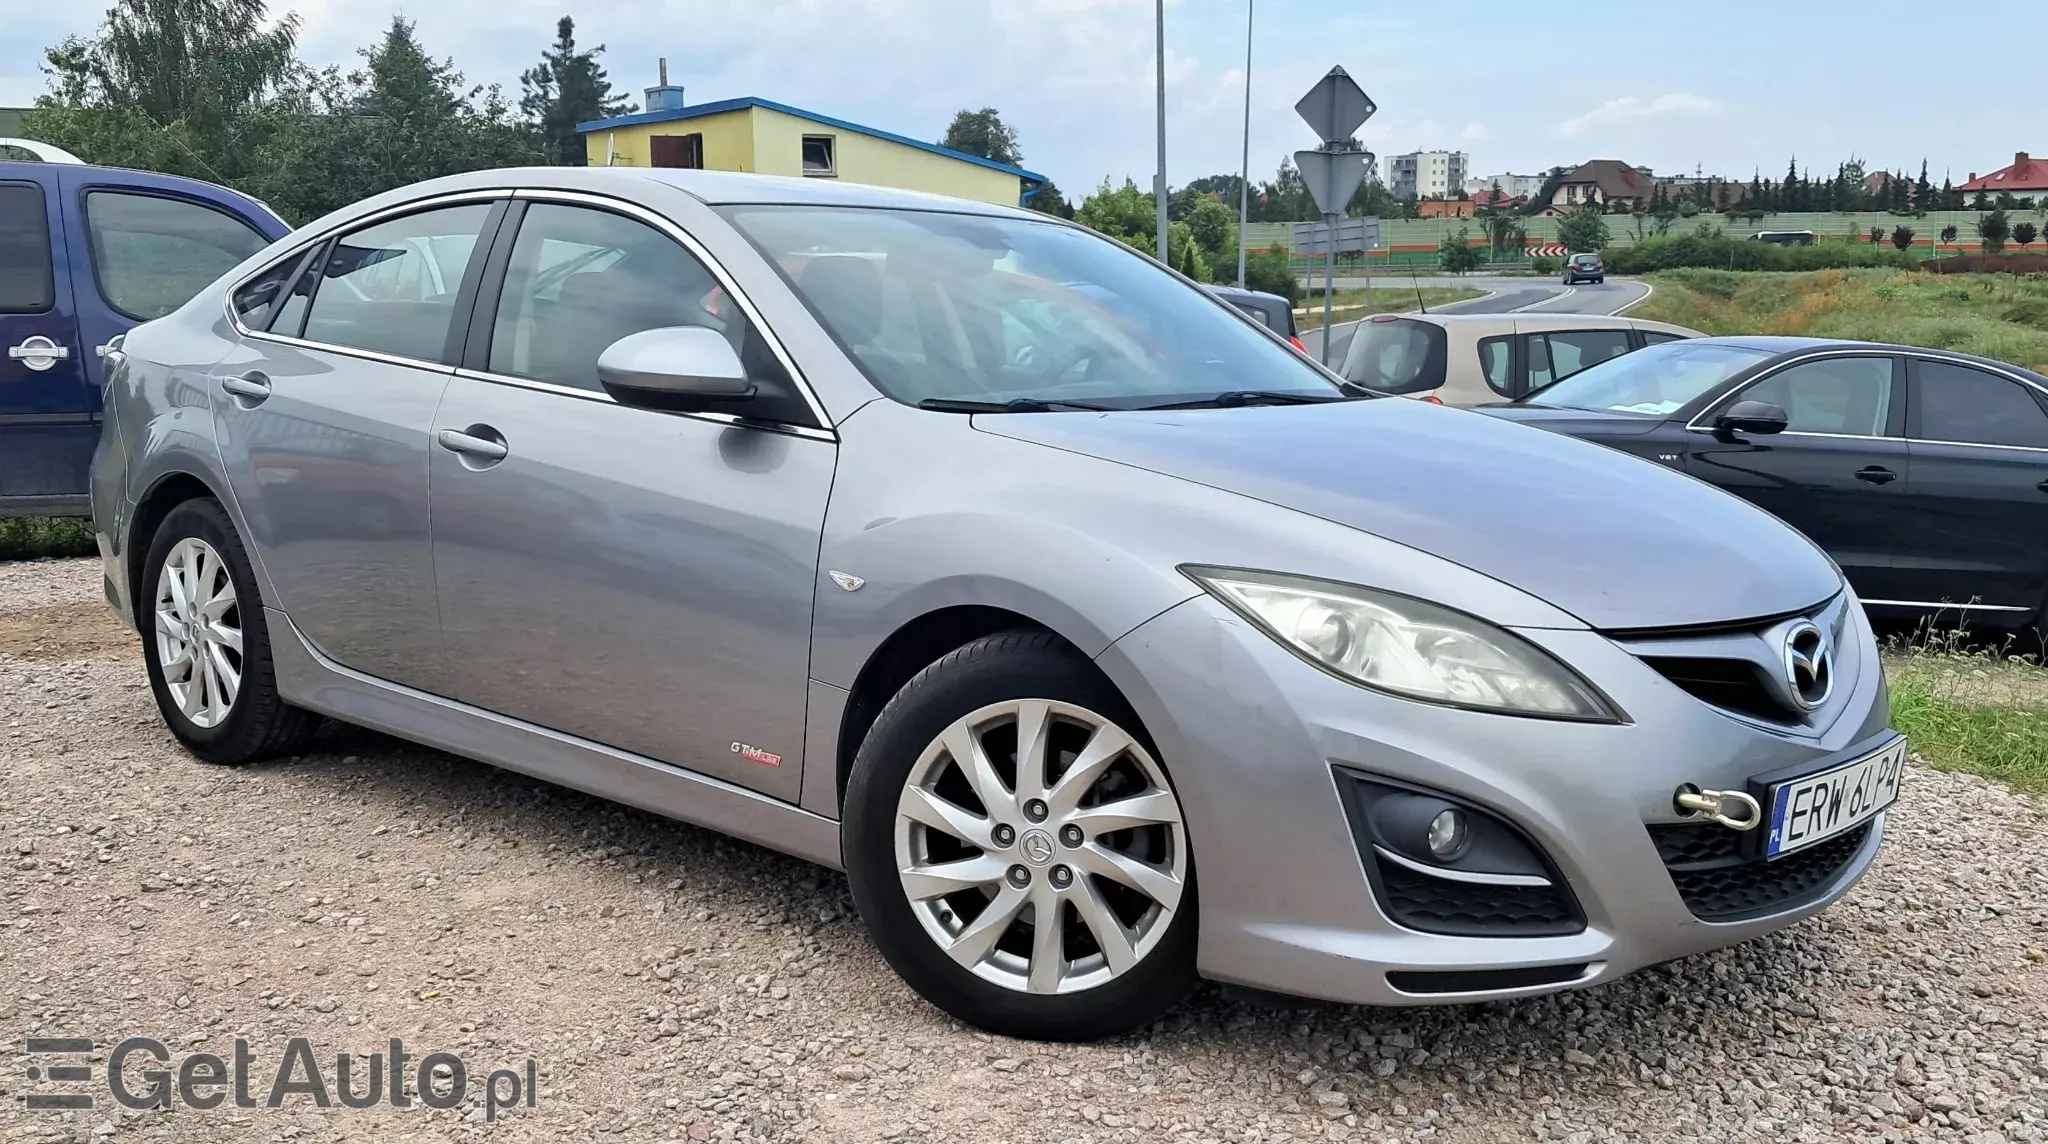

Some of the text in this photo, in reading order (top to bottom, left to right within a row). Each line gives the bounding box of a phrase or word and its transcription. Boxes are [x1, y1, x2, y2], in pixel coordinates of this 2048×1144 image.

[1788, 748, 1902, 842] ERW 6LP4
[1769, 829, 1780, 844] PL
